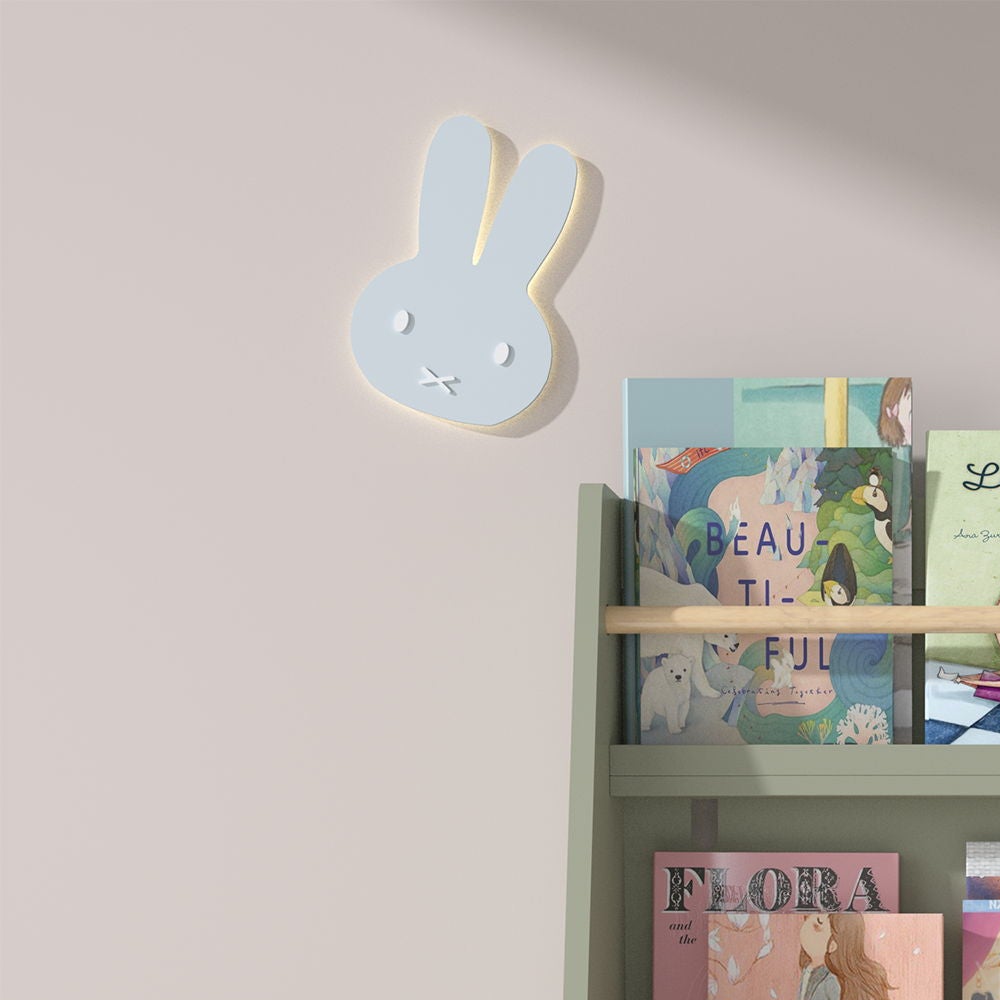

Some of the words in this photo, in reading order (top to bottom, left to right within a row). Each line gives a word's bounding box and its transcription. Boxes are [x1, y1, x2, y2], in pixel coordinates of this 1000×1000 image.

[707, 521, 829, 556] BEAU-
[953, 528, 978, 539] Ana
[765, 636, 830, 671] FUL
[661, 866, 892, 913] FLORA
[669, 920, 692, 931] and
[679, 934, 697, 945] the
